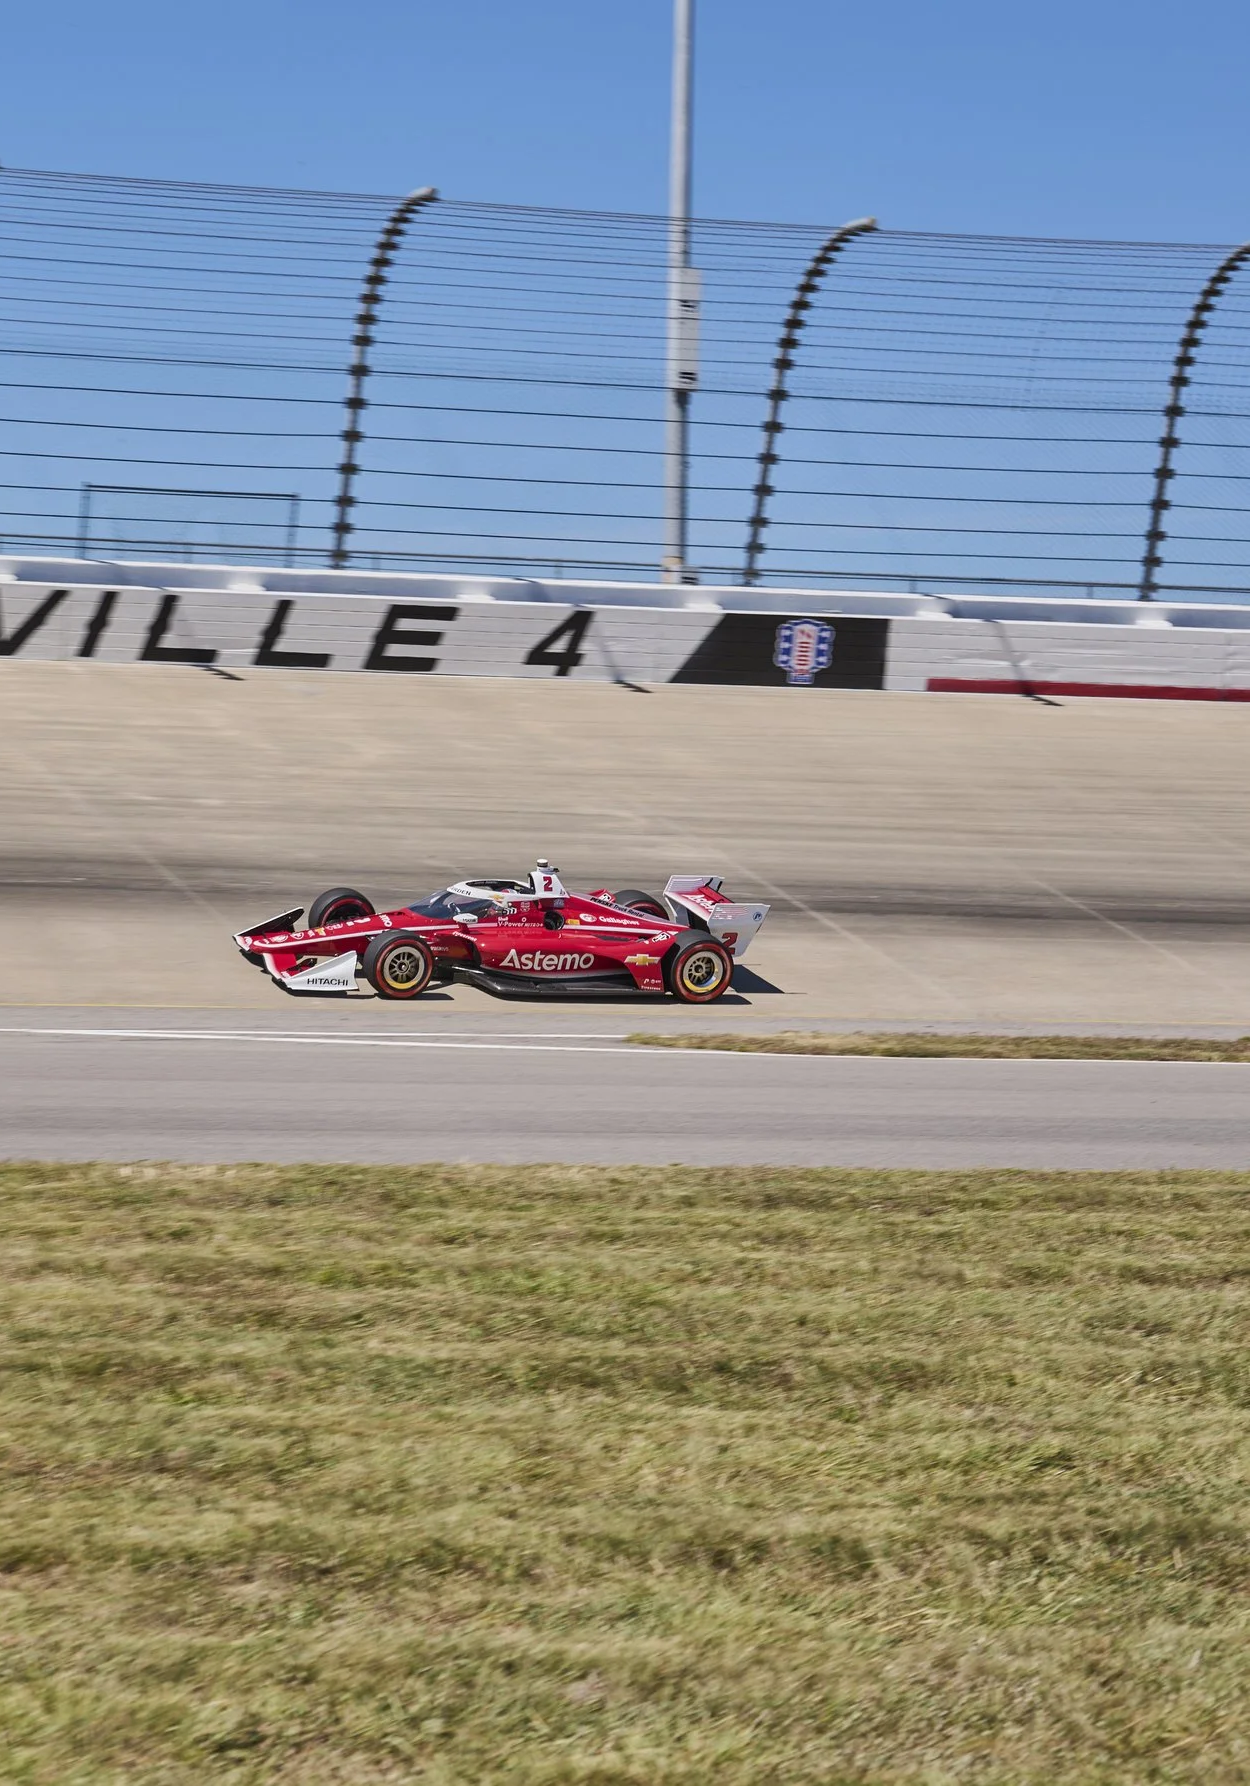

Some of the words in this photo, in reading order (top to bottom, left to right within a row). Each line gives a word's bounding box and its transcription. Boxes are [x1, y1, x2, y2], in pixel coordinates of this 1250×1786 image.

[526, 609, 594, 677] 4
[542, 876, 554, 892] 2
[721, 932, 738, 955] 2
[500, 948, 595, 971] Astemo
[307, 978, 349, 986] HITACHI
